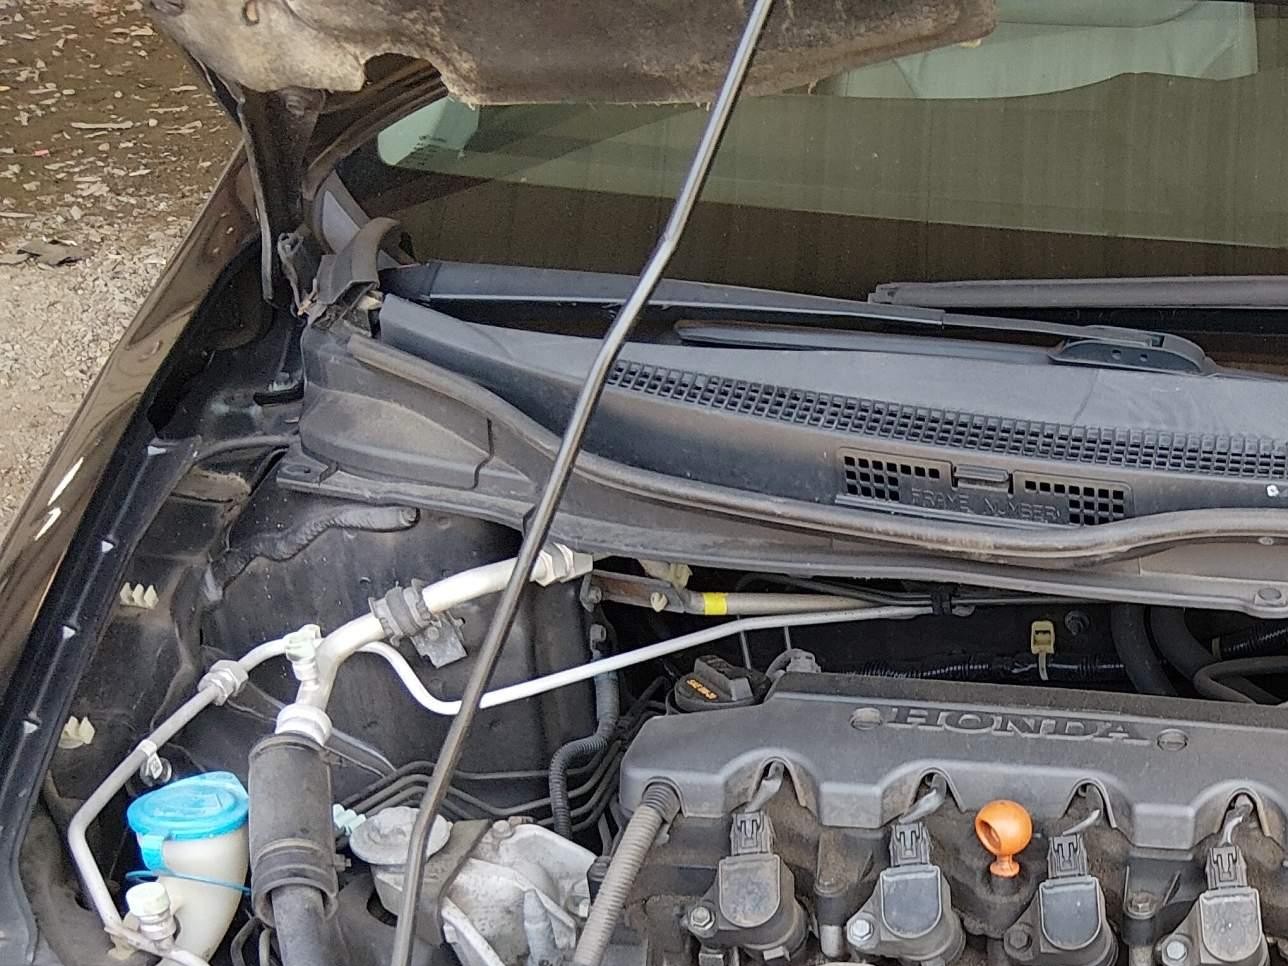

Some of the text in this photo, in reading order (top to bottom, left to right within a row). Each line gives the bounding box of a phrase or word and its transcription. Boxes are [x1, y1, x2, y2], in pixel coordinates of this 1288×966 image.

[911, 487, 1063, 524] FRAME NUMBER
[884, 706, 1150, 746] HONDA
